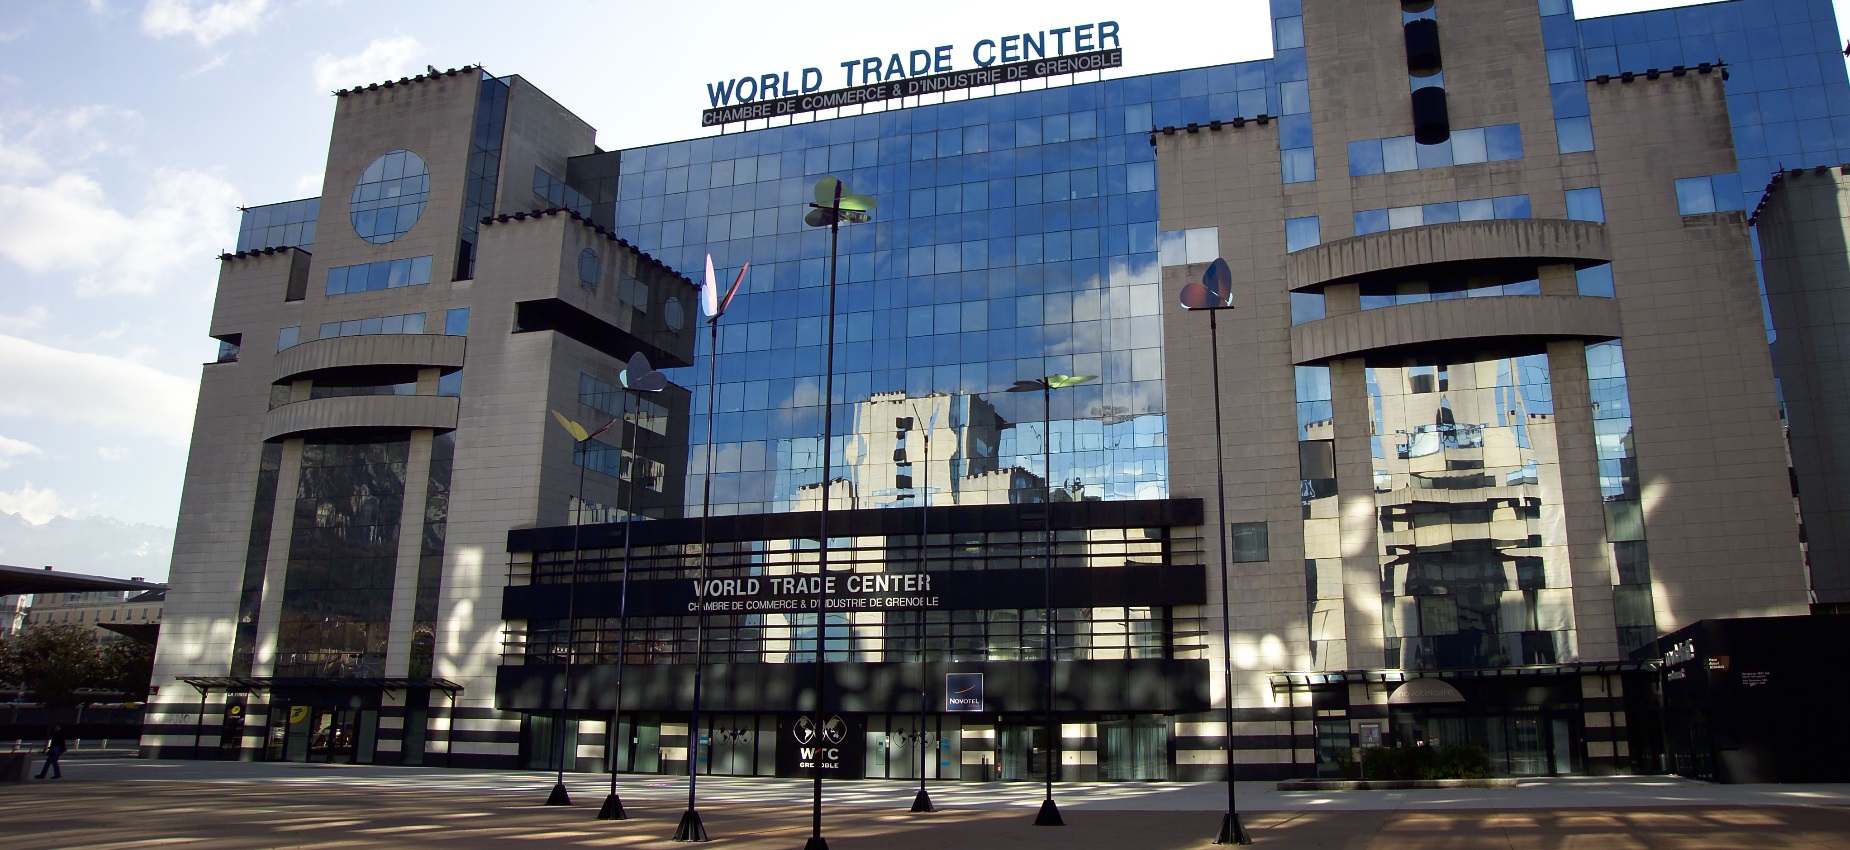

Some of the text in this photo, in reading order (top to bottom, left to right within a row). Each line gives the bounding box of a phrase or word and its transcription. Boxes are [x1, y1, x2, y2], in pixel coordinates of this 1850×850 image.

[707, 20, 1121, 107] WORLD TRADE CENTER
[703, 51, 1122, 126] CHAMBRE DE COMMERCE & D'INDUSTRIE DE GRENOBLE
[693, 574, 931, 597] WORLD TRADE CENTER
[731, 601, 744, 610] DE
[746, 599, 799, 610] COMMERCE
[800, 599, 807, 609] &
[869, 597, 883, 607] DE
[800, 747, 839, 761] WTC
